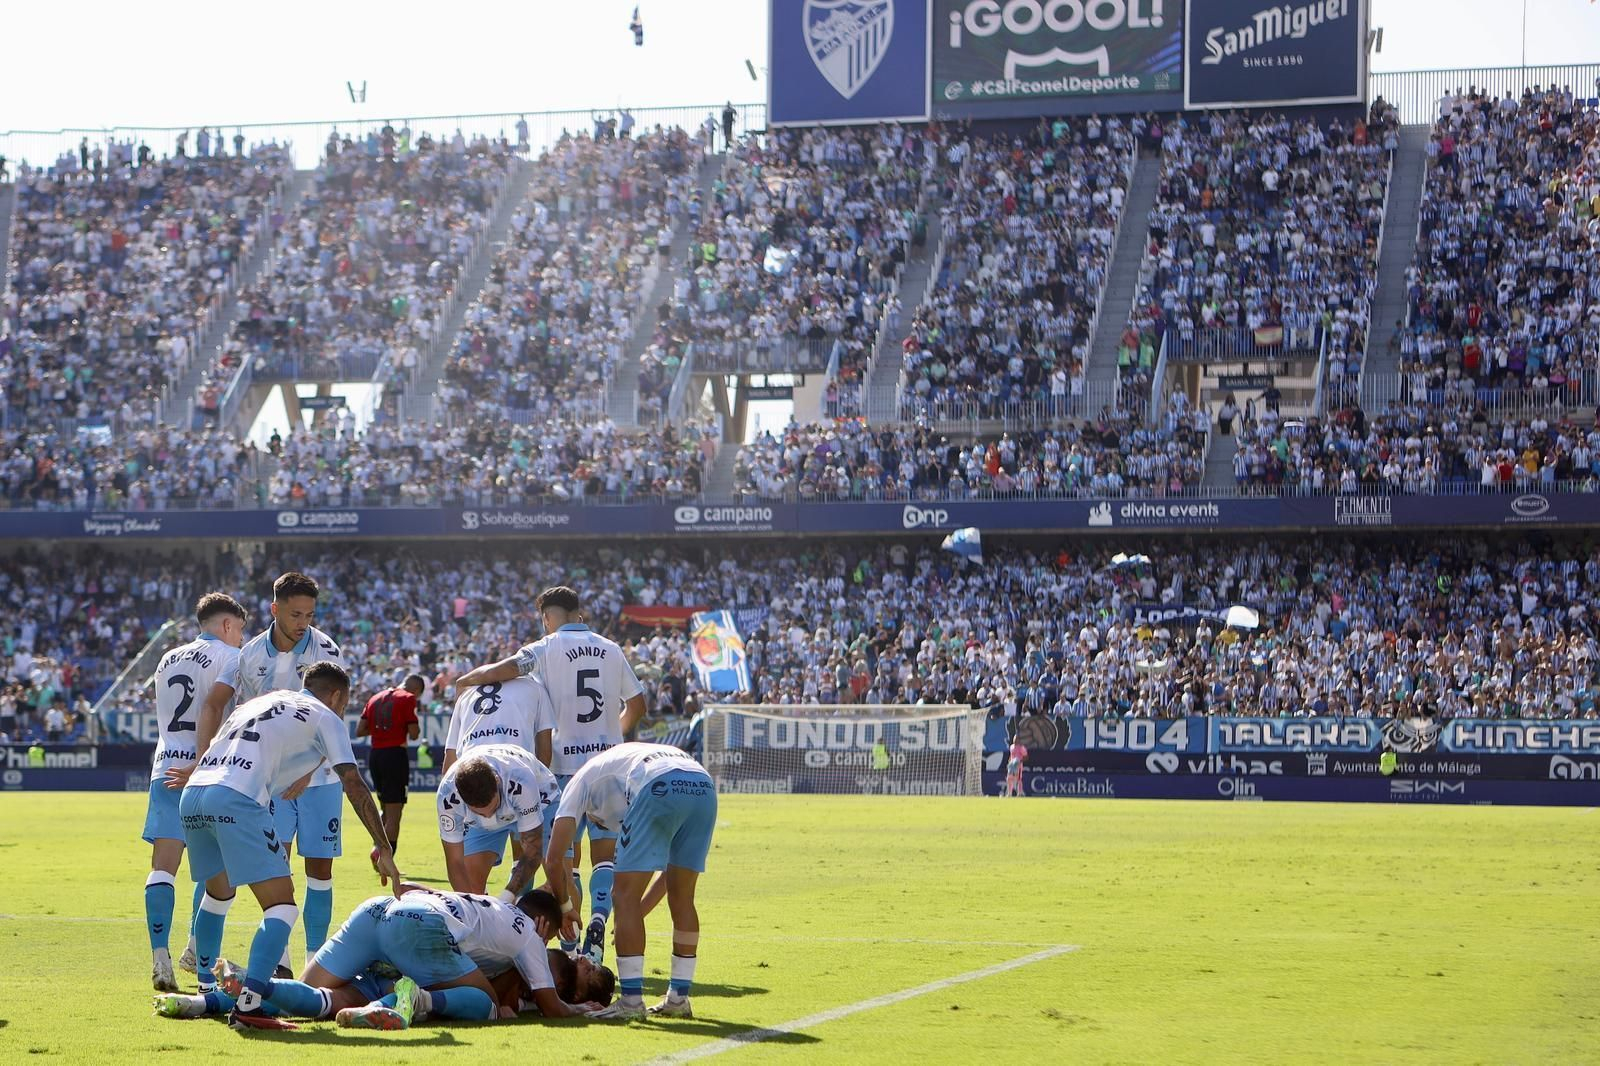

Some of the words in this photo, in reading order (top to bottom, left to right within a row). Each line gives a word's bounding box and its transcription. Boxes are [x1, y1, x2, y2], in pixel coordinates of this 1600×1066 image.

[1243, 57, 1273, 68] SINCE
[1277, 55, 1304, 67] 1890
[703, 507, 773, 525] campano
[1120, 501, 1166, 518] divina
[1169, 501, 1220, 518] events
[301, 512, 359, 528] campano
[565, 646, 607, 662] JUANDE
[167, 674, 196, 732] 2
[473, 682, 503, 716] 8
[576, 669, 604, 723] 5
[743, 718, 883, 750] FONDO
[1083, 719, 1189, 750] 1904
[564, 742, 617, 755] BENAHA
[1419, 761, 1434, 774] de
[1437, 759, 1481, 776] Málaga
[671, 780, 698, 788] COSTA
[1030, 776, 1115, 795] CaixaBank
[1217, 777, 1256, 796] Olin
[1390, 779, 1465, 794] SWM
[218, 816, 237, 824] SOL
[407, 911, 425, 922] SOL
